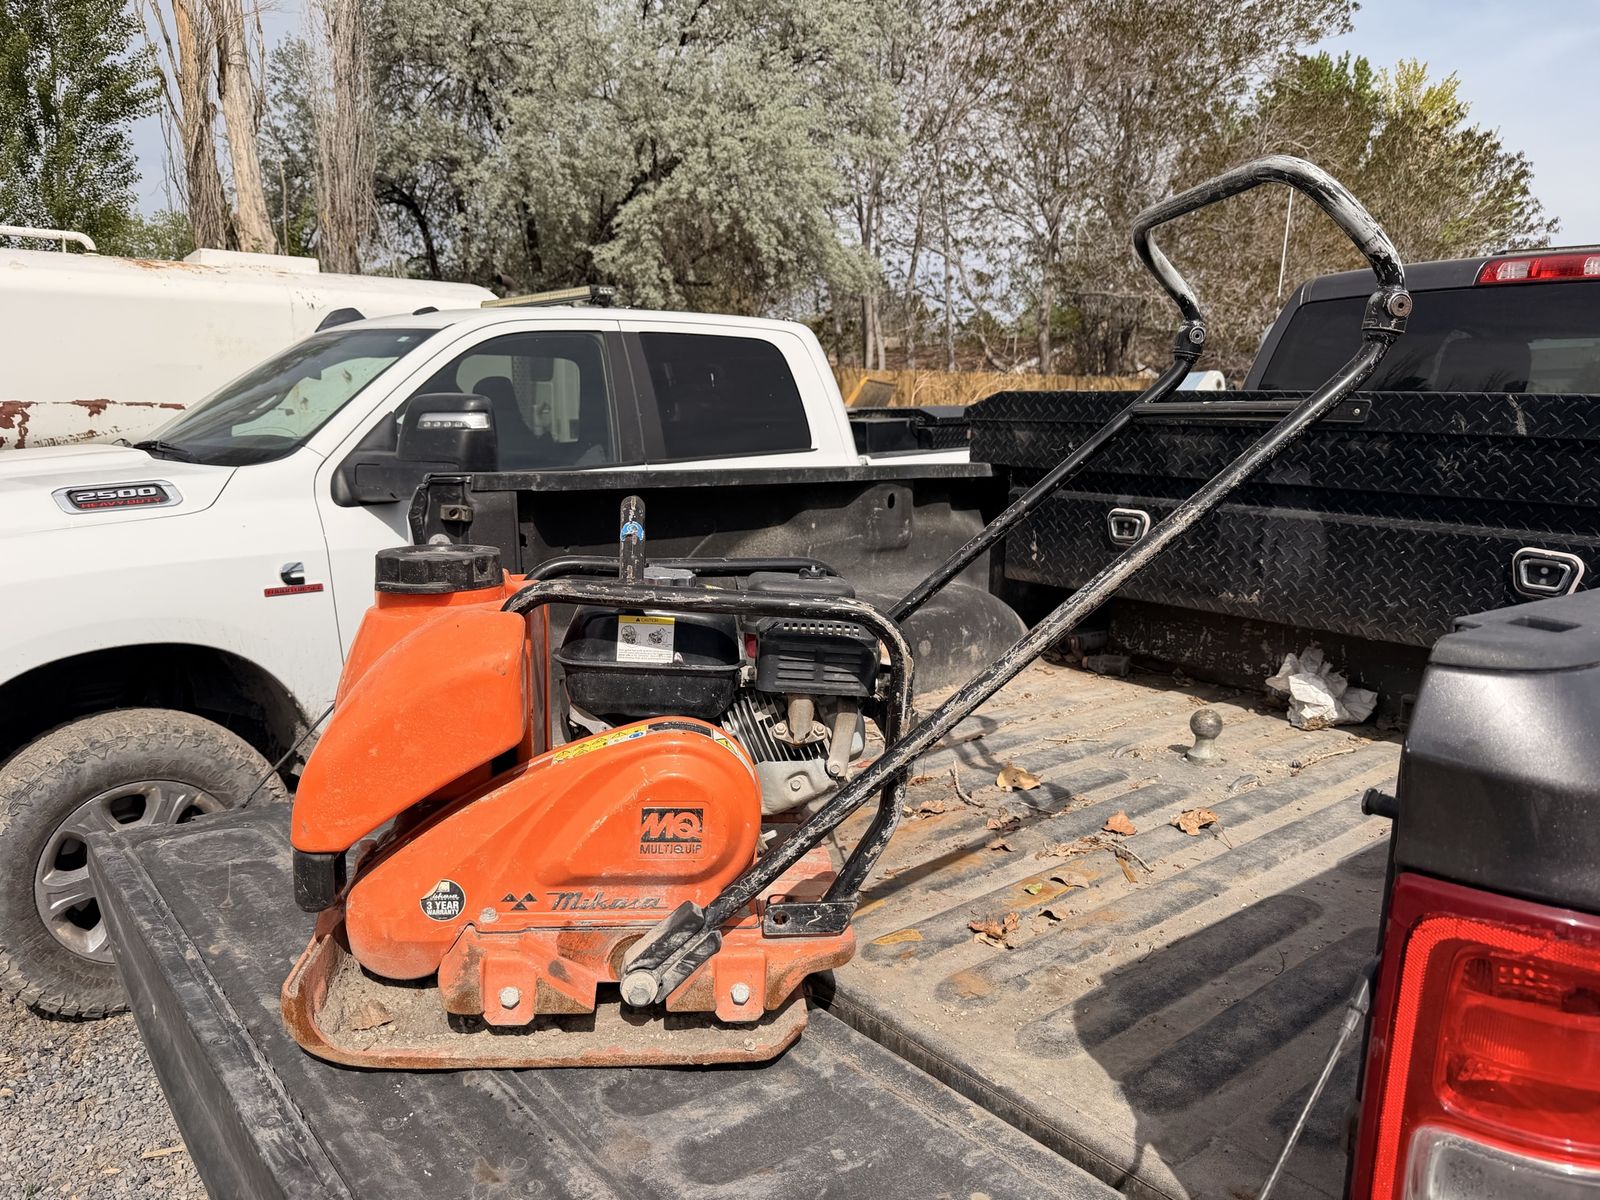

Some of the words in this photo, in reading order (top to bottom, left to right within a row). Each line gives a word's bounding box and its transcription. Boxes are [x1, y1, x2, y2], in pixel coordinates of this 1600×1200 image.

[76, 487, 157, 501] 2500
[80, 500, 124, 509] HEAVY
[126, 497, 161, 505] DUTY
[641, 811, 703, 840] MQ
[640, 844, 702, 855] MULTIQUIP
[426, 901, 433, 910] 3
[435, 901, 459, 910] YEAR
[547, 891, 668, 910] Mikasa
